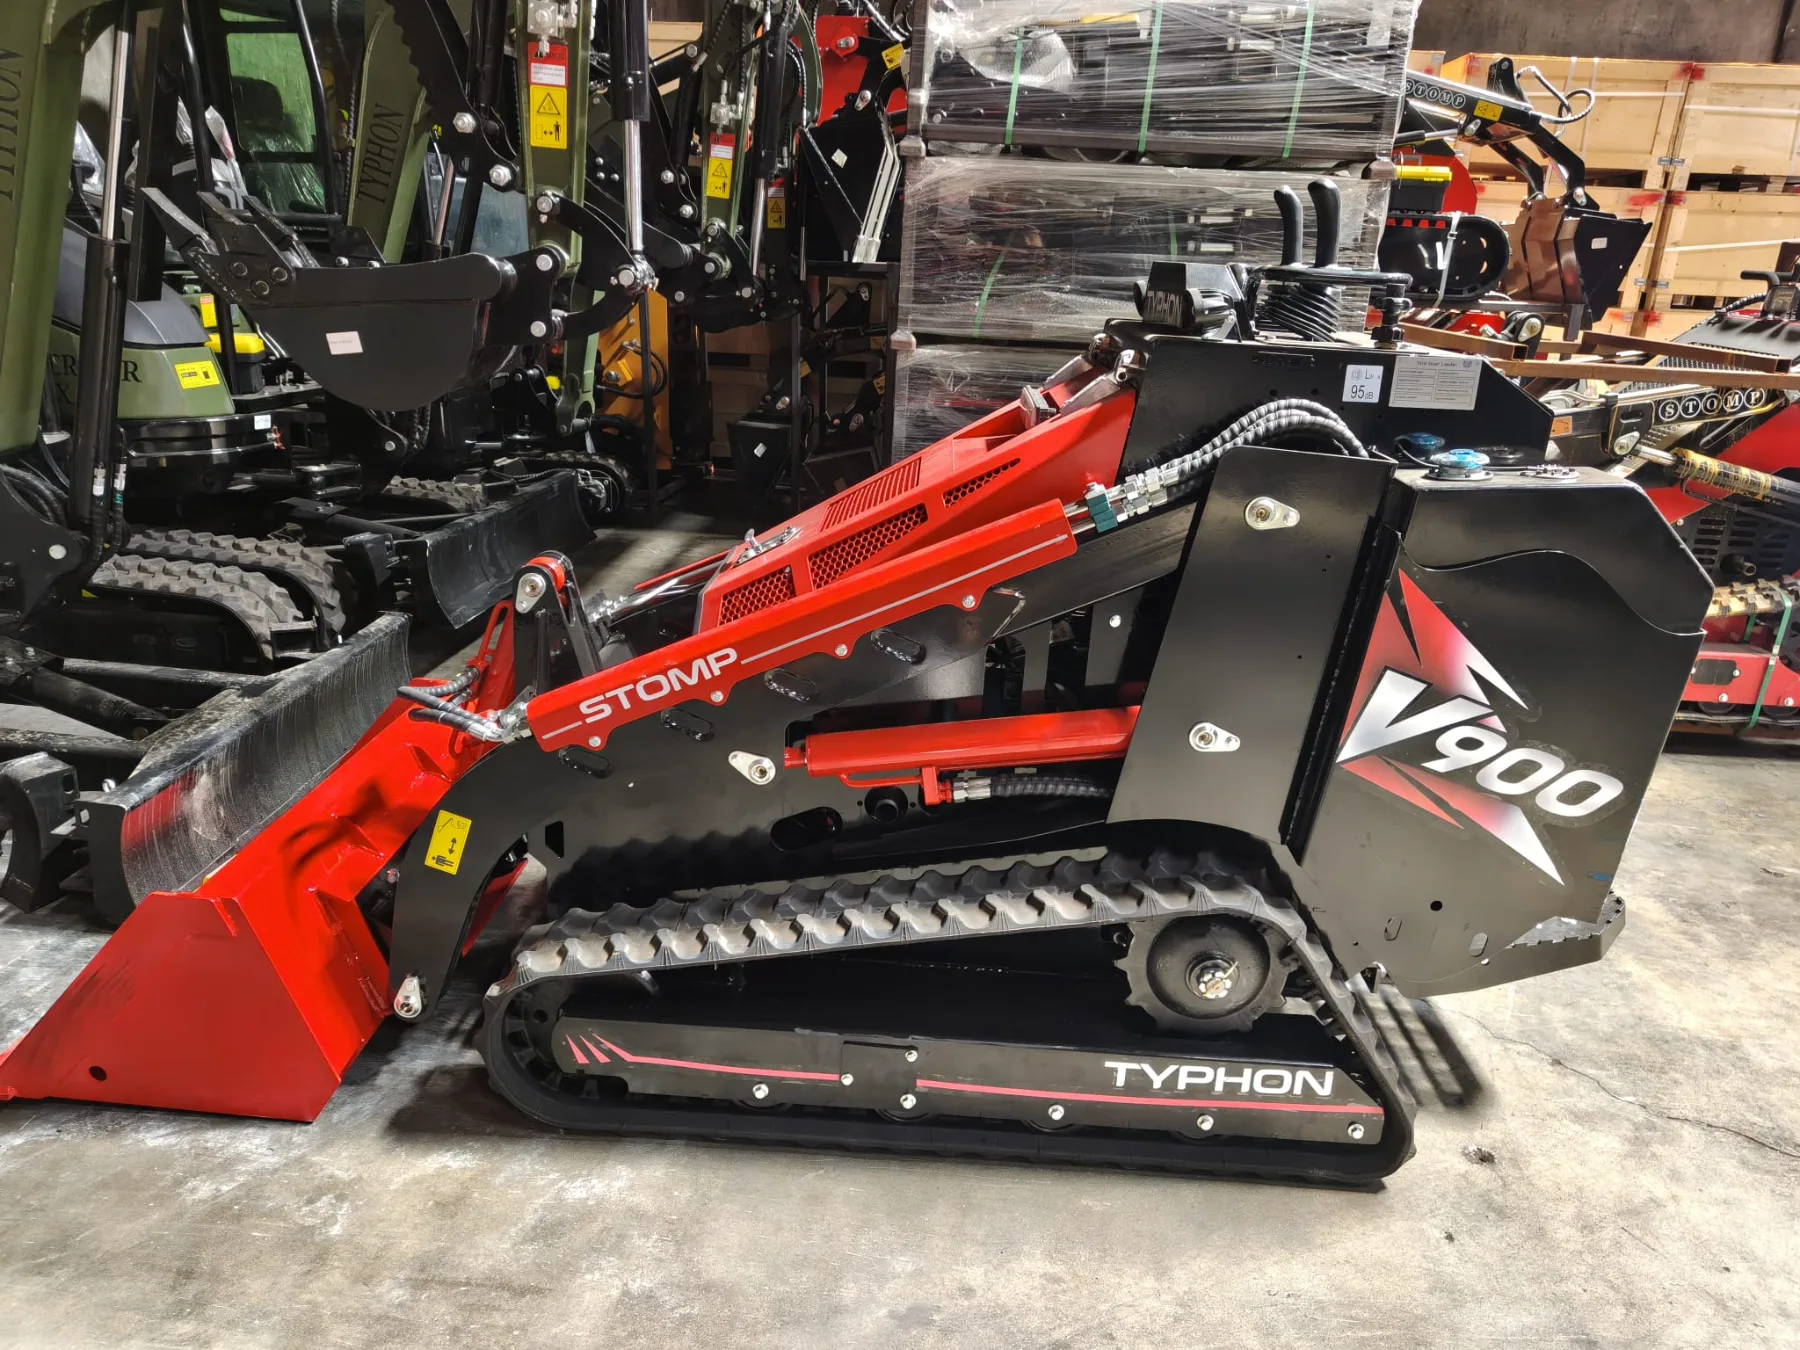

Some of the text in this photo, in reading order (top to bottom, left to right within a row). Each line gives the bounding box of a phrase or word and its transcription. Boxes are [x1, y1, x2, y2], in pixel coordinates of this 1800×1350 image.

[1401, 80, 1465, 107] STOMP
[356, 102, 404, 204] TYPHON
[1660, 388, 1764, 420] STOMP
[579, 647, 738, 723] STOMP
[1336, 669, 1624, 817] V900
[1104, 1061, 1334, 1096] TYPHON
